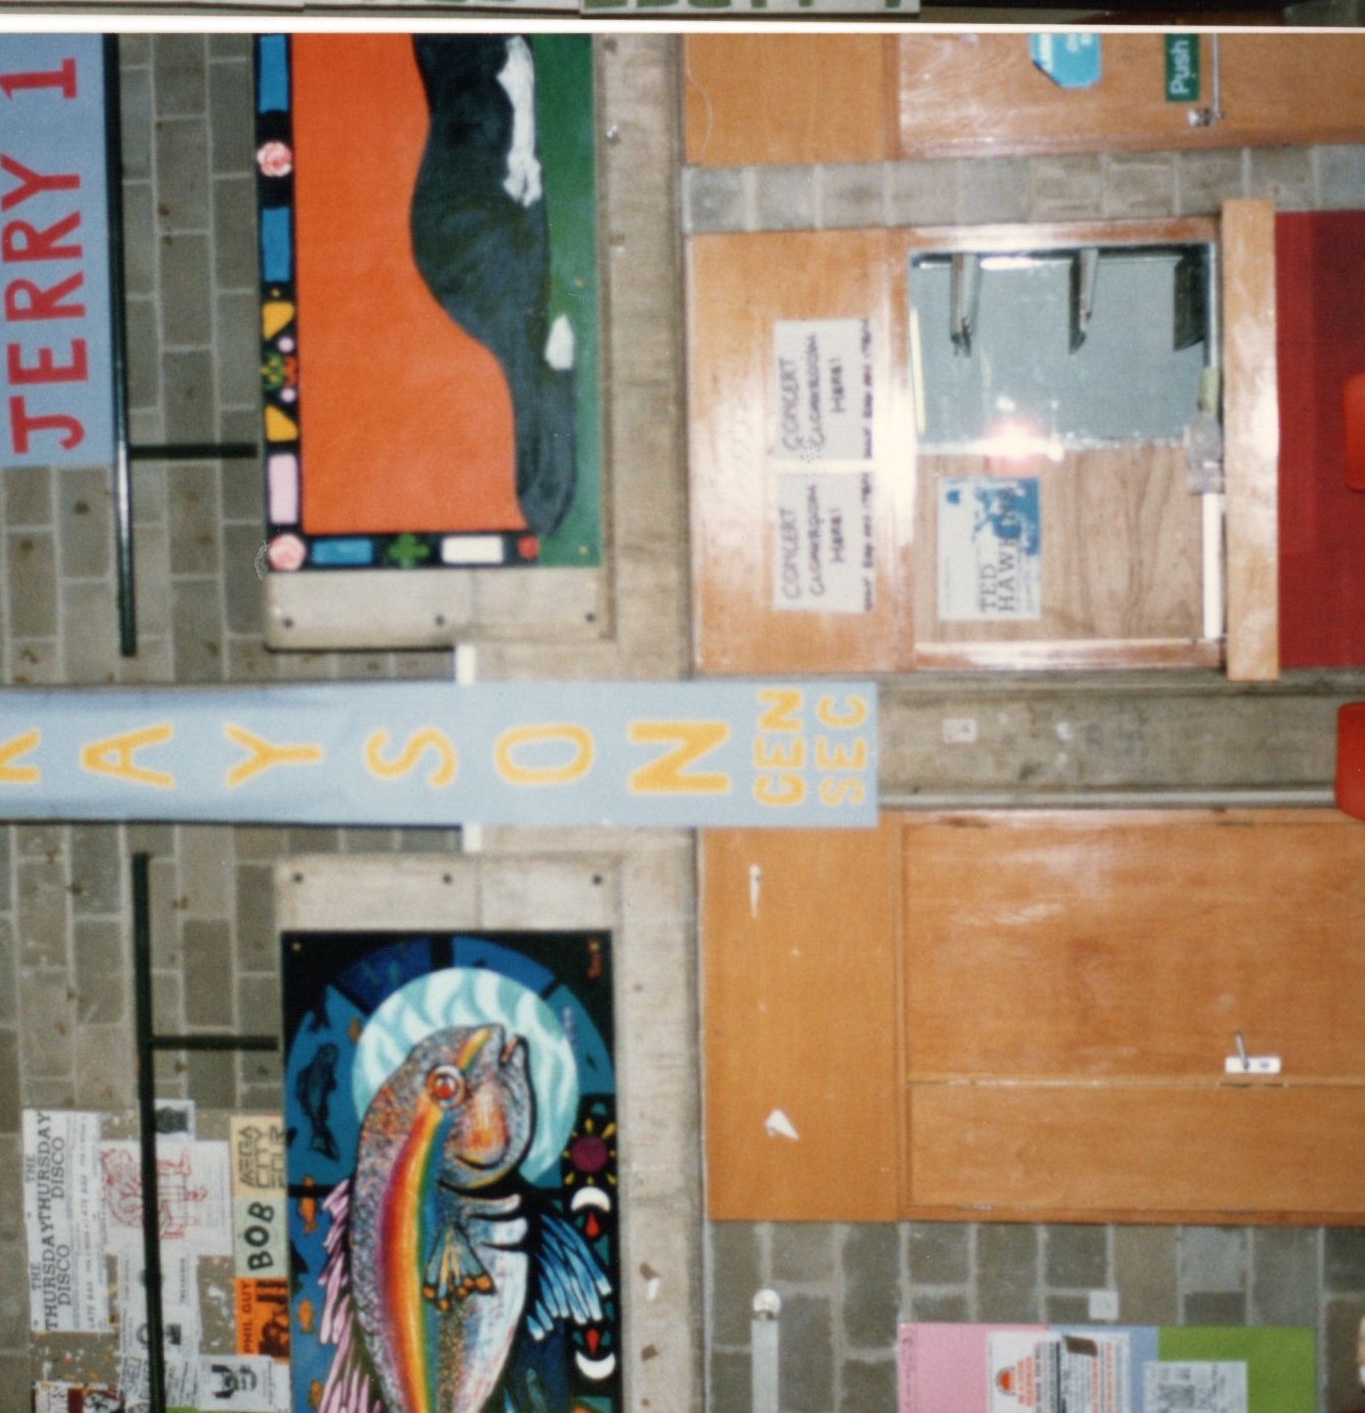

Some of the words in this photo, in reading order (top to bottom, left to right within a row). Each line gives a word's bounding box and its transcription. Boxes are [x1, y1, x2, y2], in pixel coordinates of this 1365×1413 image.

[1170, 40, 1191, 95] Push
[0, 154, 89, 454] JERRY
[779, 357, 800, 451] CONCERT
[779, 506, 801, 600] CONCERT
[980, 564, 997, 613] TED
[753, 688, 805, 806] GEN
[816, 694, 868, 806] SEC
[25, 1154, 37, 1183] THE
[36, 1113, 53, 1223] THURSDAY
[51, 1136, 66, 1200] DISCO
[243, 1201, 275, 1271] BOB
[30, 1262, 42, 1292] THE
[41, 1221, 58, 1331] THURSDAY
[56, 1244, 72, 1306] DISCO
[241, 1281, 252, 1315] GUY
[242, 1318, 252, 1353] PHIL
